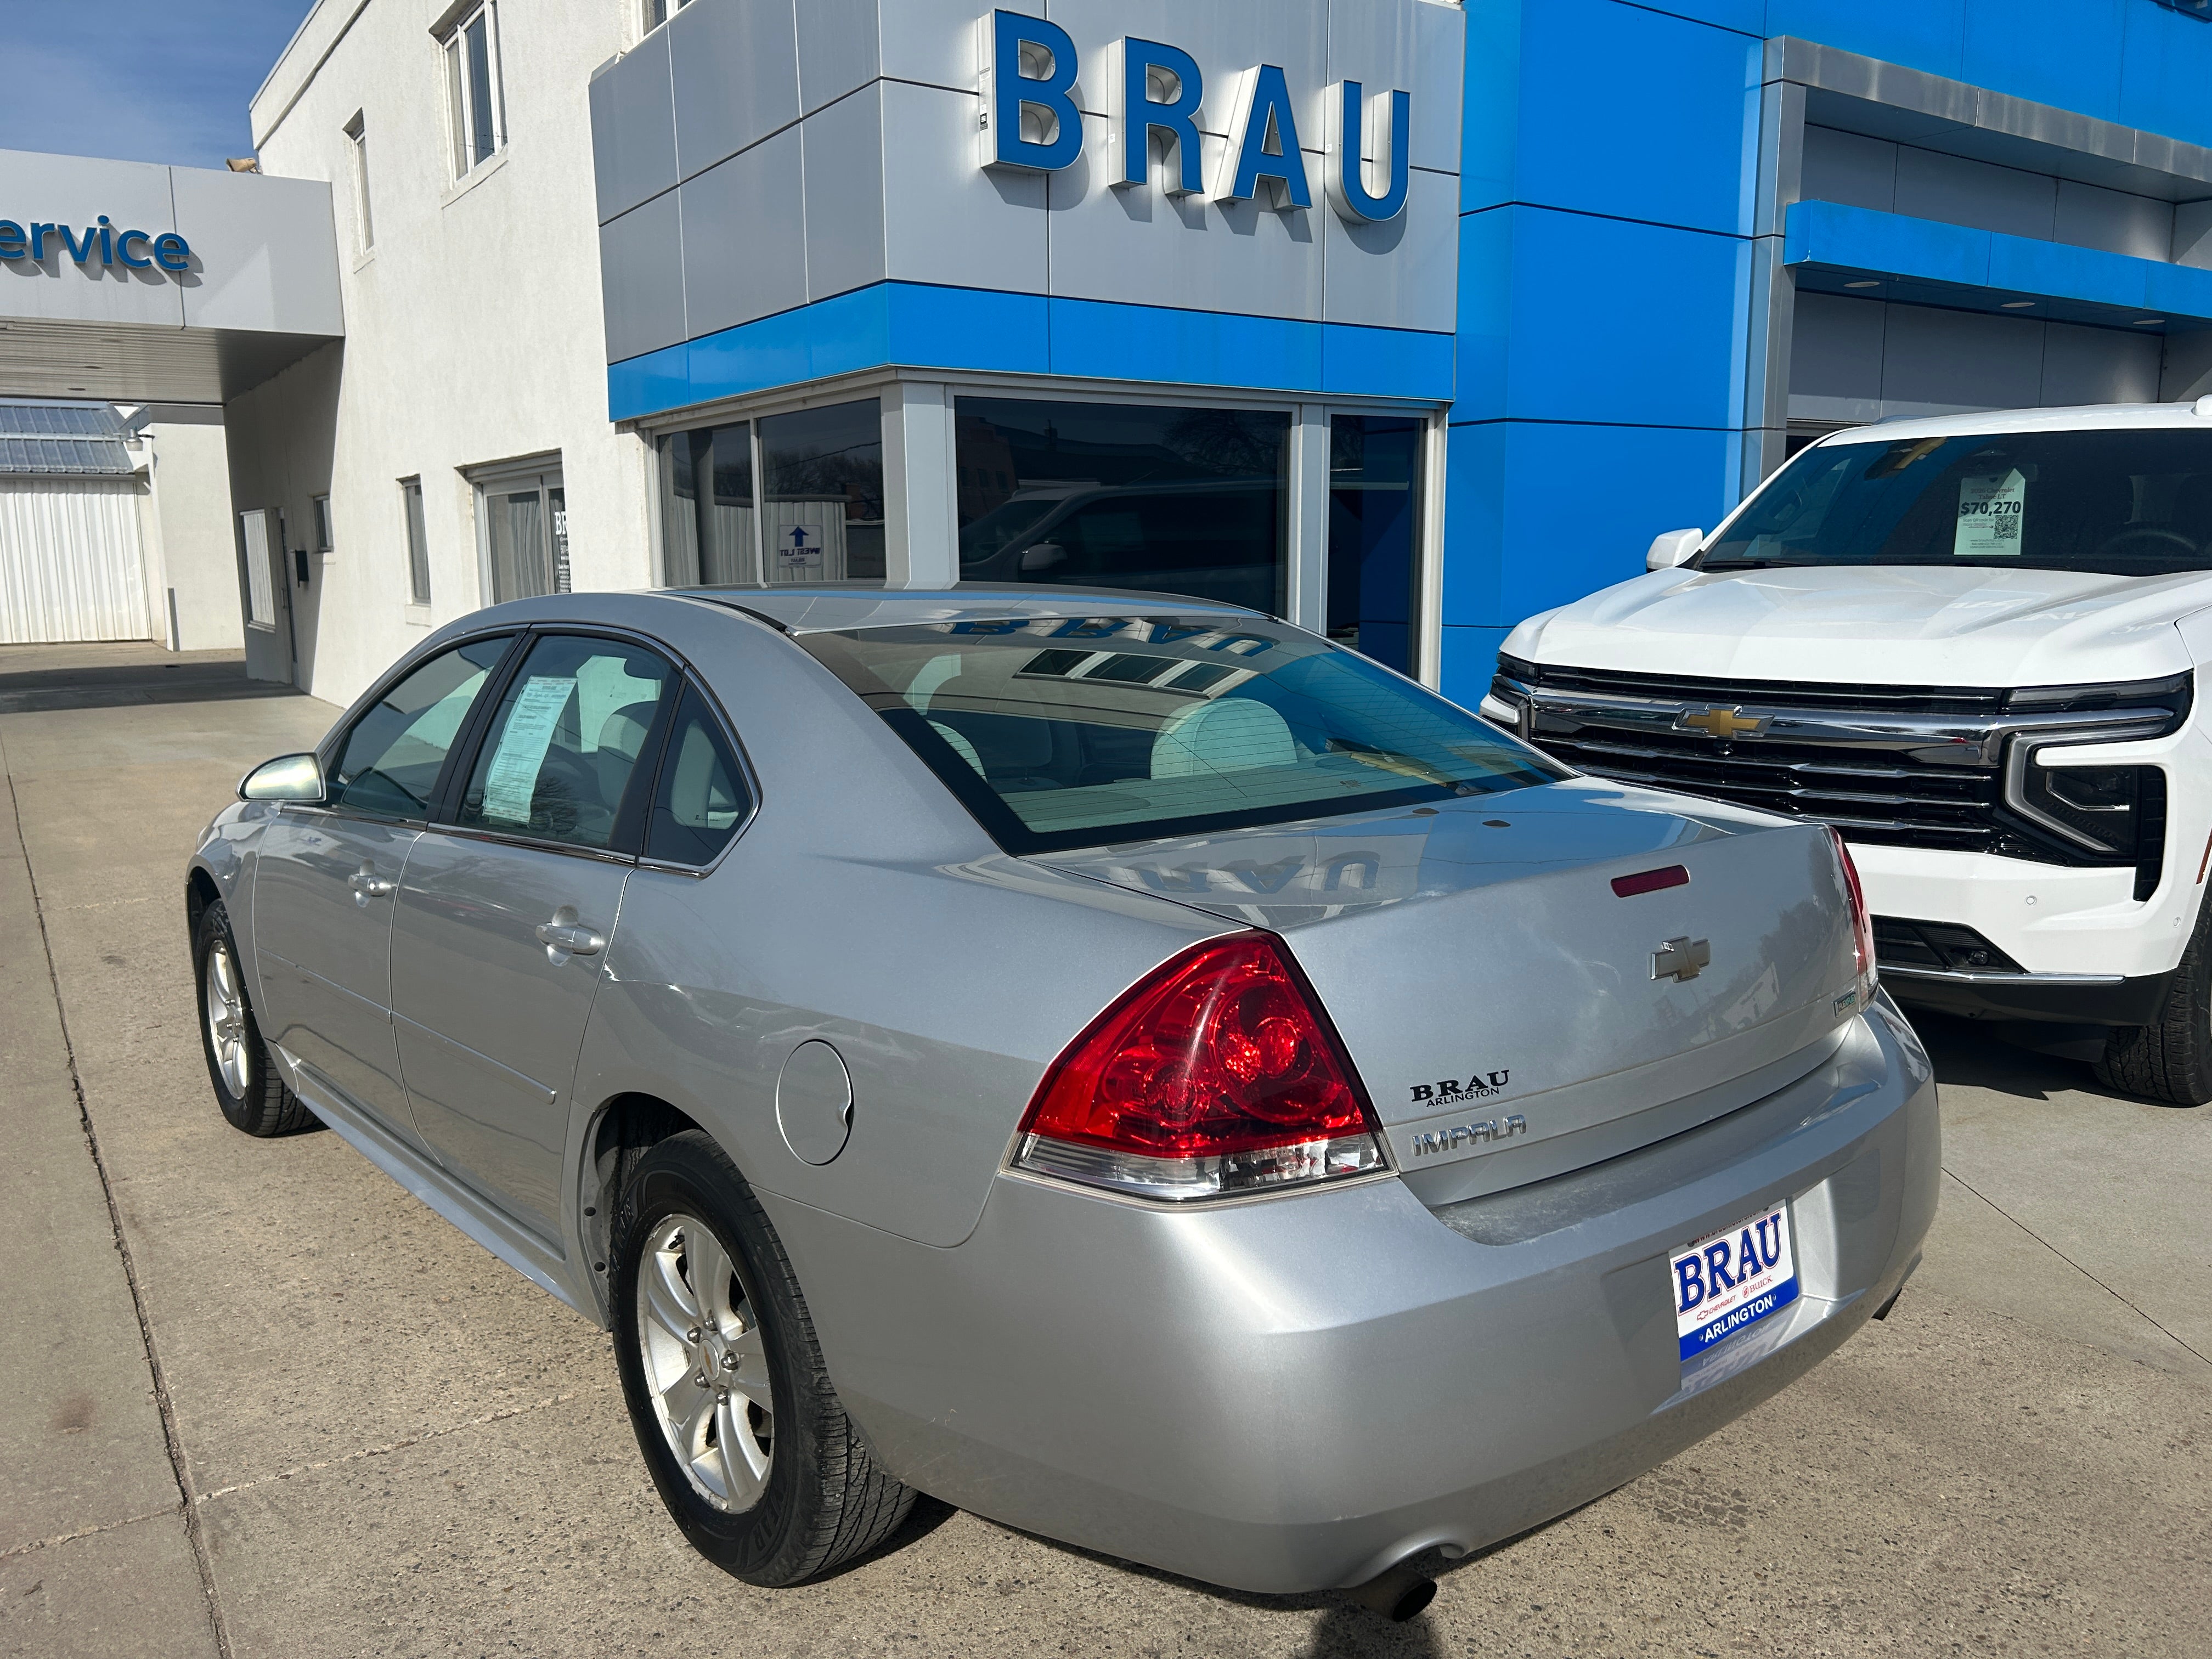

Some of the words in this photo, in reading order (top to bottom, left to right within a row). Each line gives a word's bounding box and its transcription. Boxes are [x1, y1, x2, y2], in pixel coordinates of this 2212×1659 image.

[994, 8, 1411, 222] BRAU
[1961, 501, 2021, 517] $70,270
[1409, 1069, 1510, 1102] BRAU
[1426, 1087, 1500, 1108] ARLINGTON
[1412, 1114, 1527, 1156] IMPALA
[1674, 1210, 1781, 1316] BRAU
[1709, 1295, 1736, 1314] CHEVROLET
[1750, 1275, 1774, 1294] BUICK
[1704, 1294, 1773, 1343] ARLINGTON
